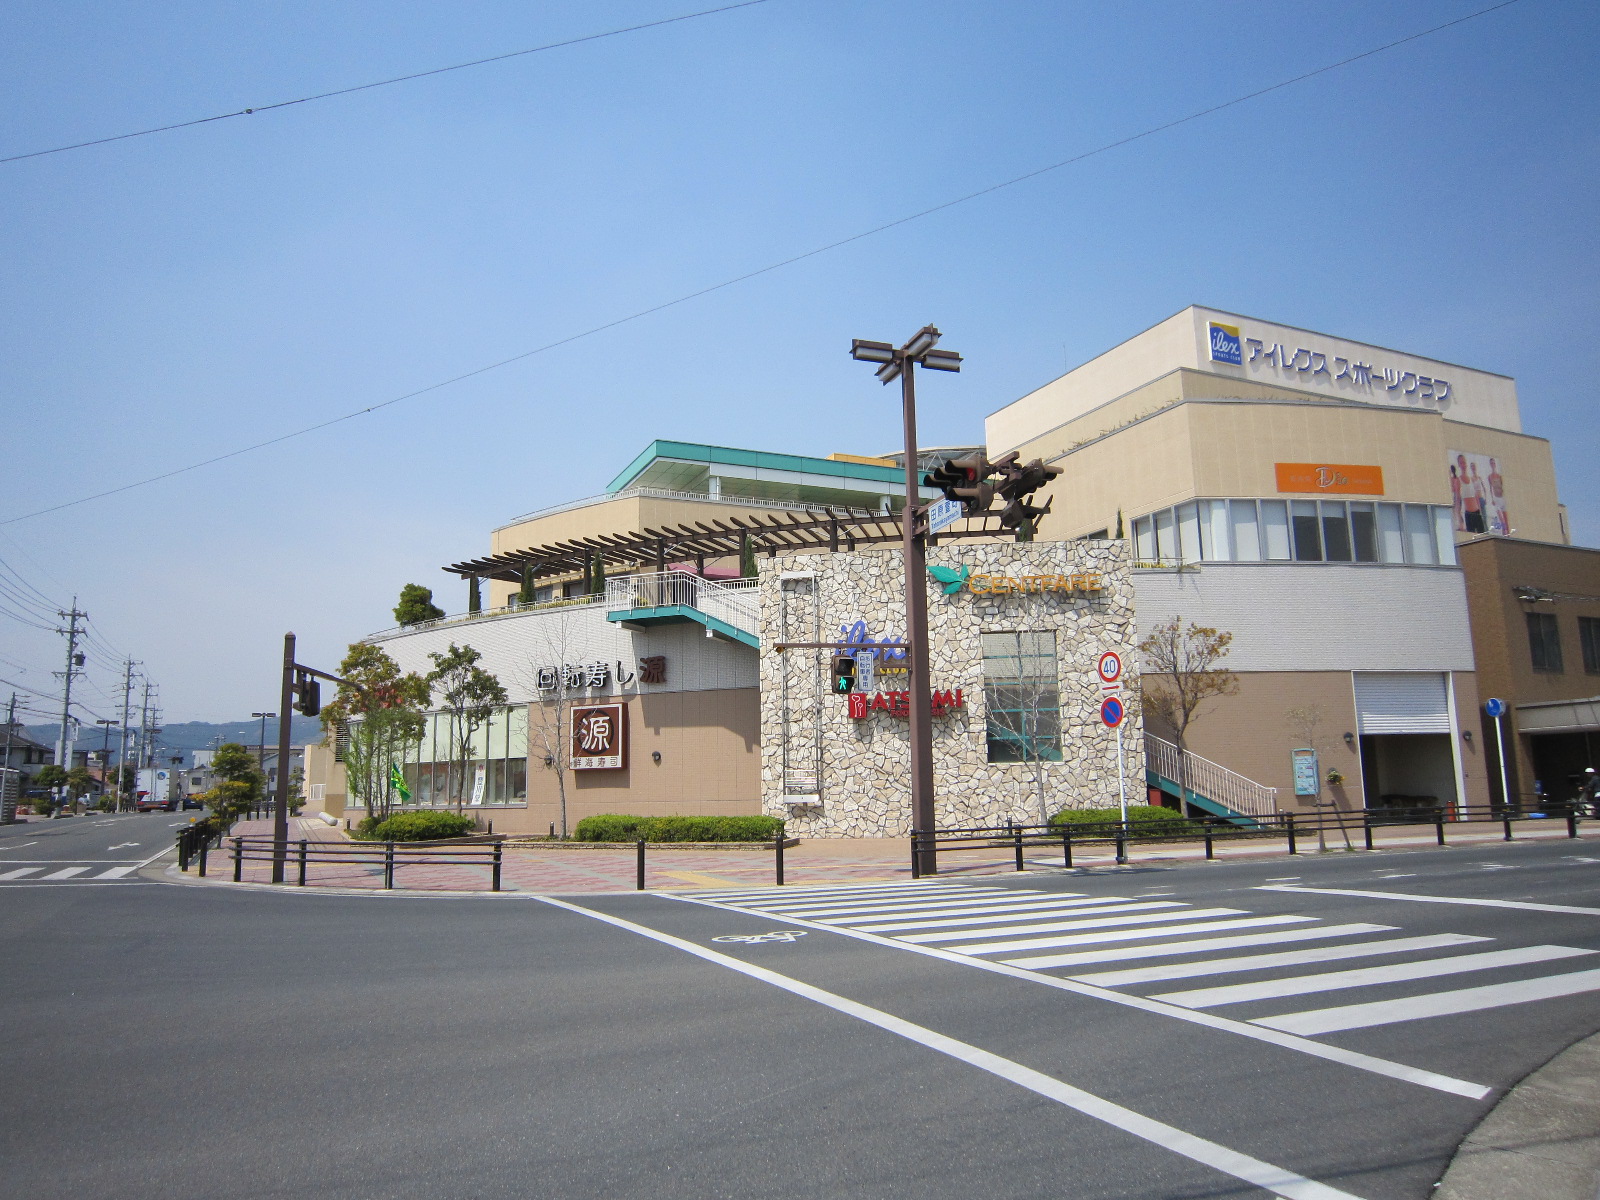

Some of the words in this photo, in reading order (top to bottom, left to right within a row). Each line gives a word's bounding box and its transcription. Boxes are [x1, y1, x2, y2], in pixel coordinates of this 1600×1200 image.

[1212, 331, 1240, 355] ilex
[1244, 337, 1332, 377] アイレクス
[1333, 356, 1452, 401] スポーツクラブ
[968, 574, 1101, 595] CENTFARE
[1103, 659, 1116, 674] 40
[870, 689, 963, 710] ATSMI
[581, 716, 610, 751] 源
